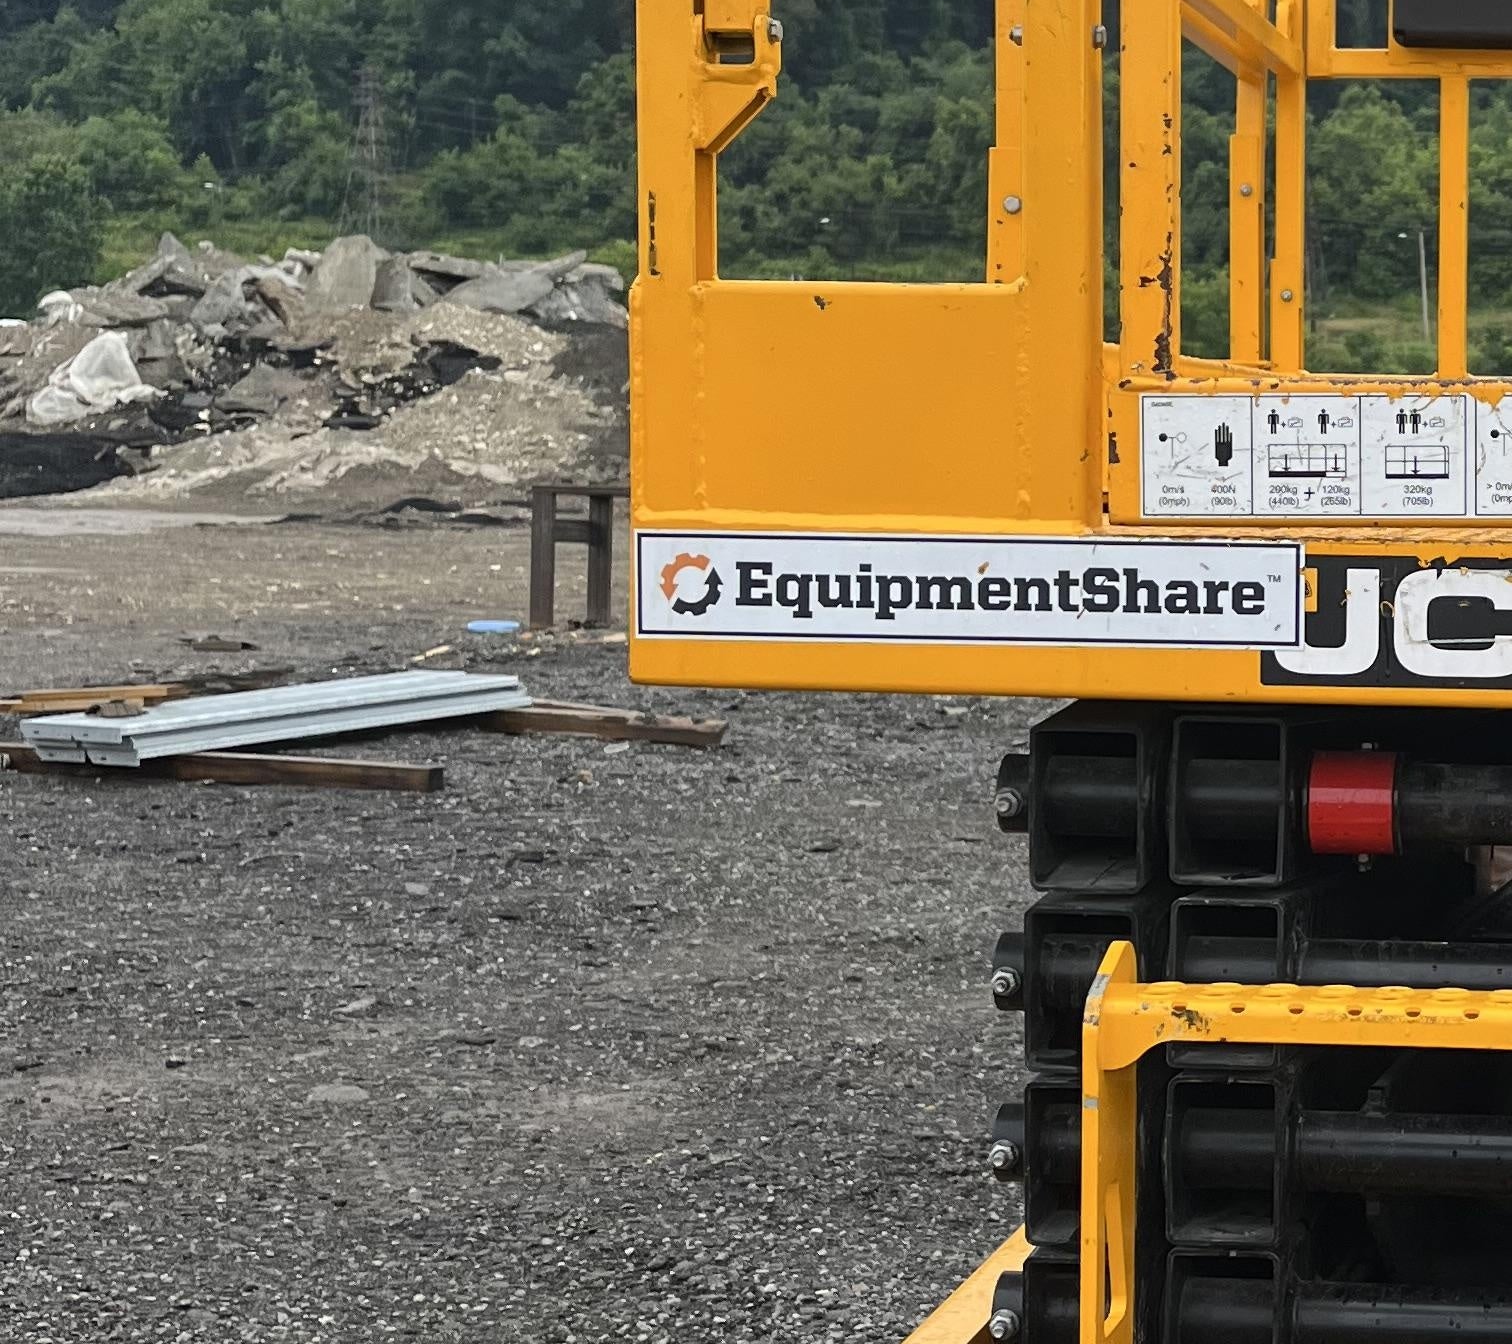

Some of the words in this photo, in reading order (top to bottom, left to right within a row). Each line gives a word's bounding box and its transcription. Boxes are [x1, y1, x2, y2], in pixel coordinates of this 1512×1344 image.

[1162, 484, 1185, 494] 0m/s
[1211, 484, 1236, 494] 400N
[1322, 484, 1350, 495] 120kg
[1403, 484, 1433, 495] 320kg
[1159, 496, 1190, 507] (0mph)
[1211, 496, 1237, 507] (90lb)
[1268, 496, 1300, 507] (440lb)
[1402, 496, 1434, 507] (705lb)
[735, 561, 1266, 621] EquipmentShare
